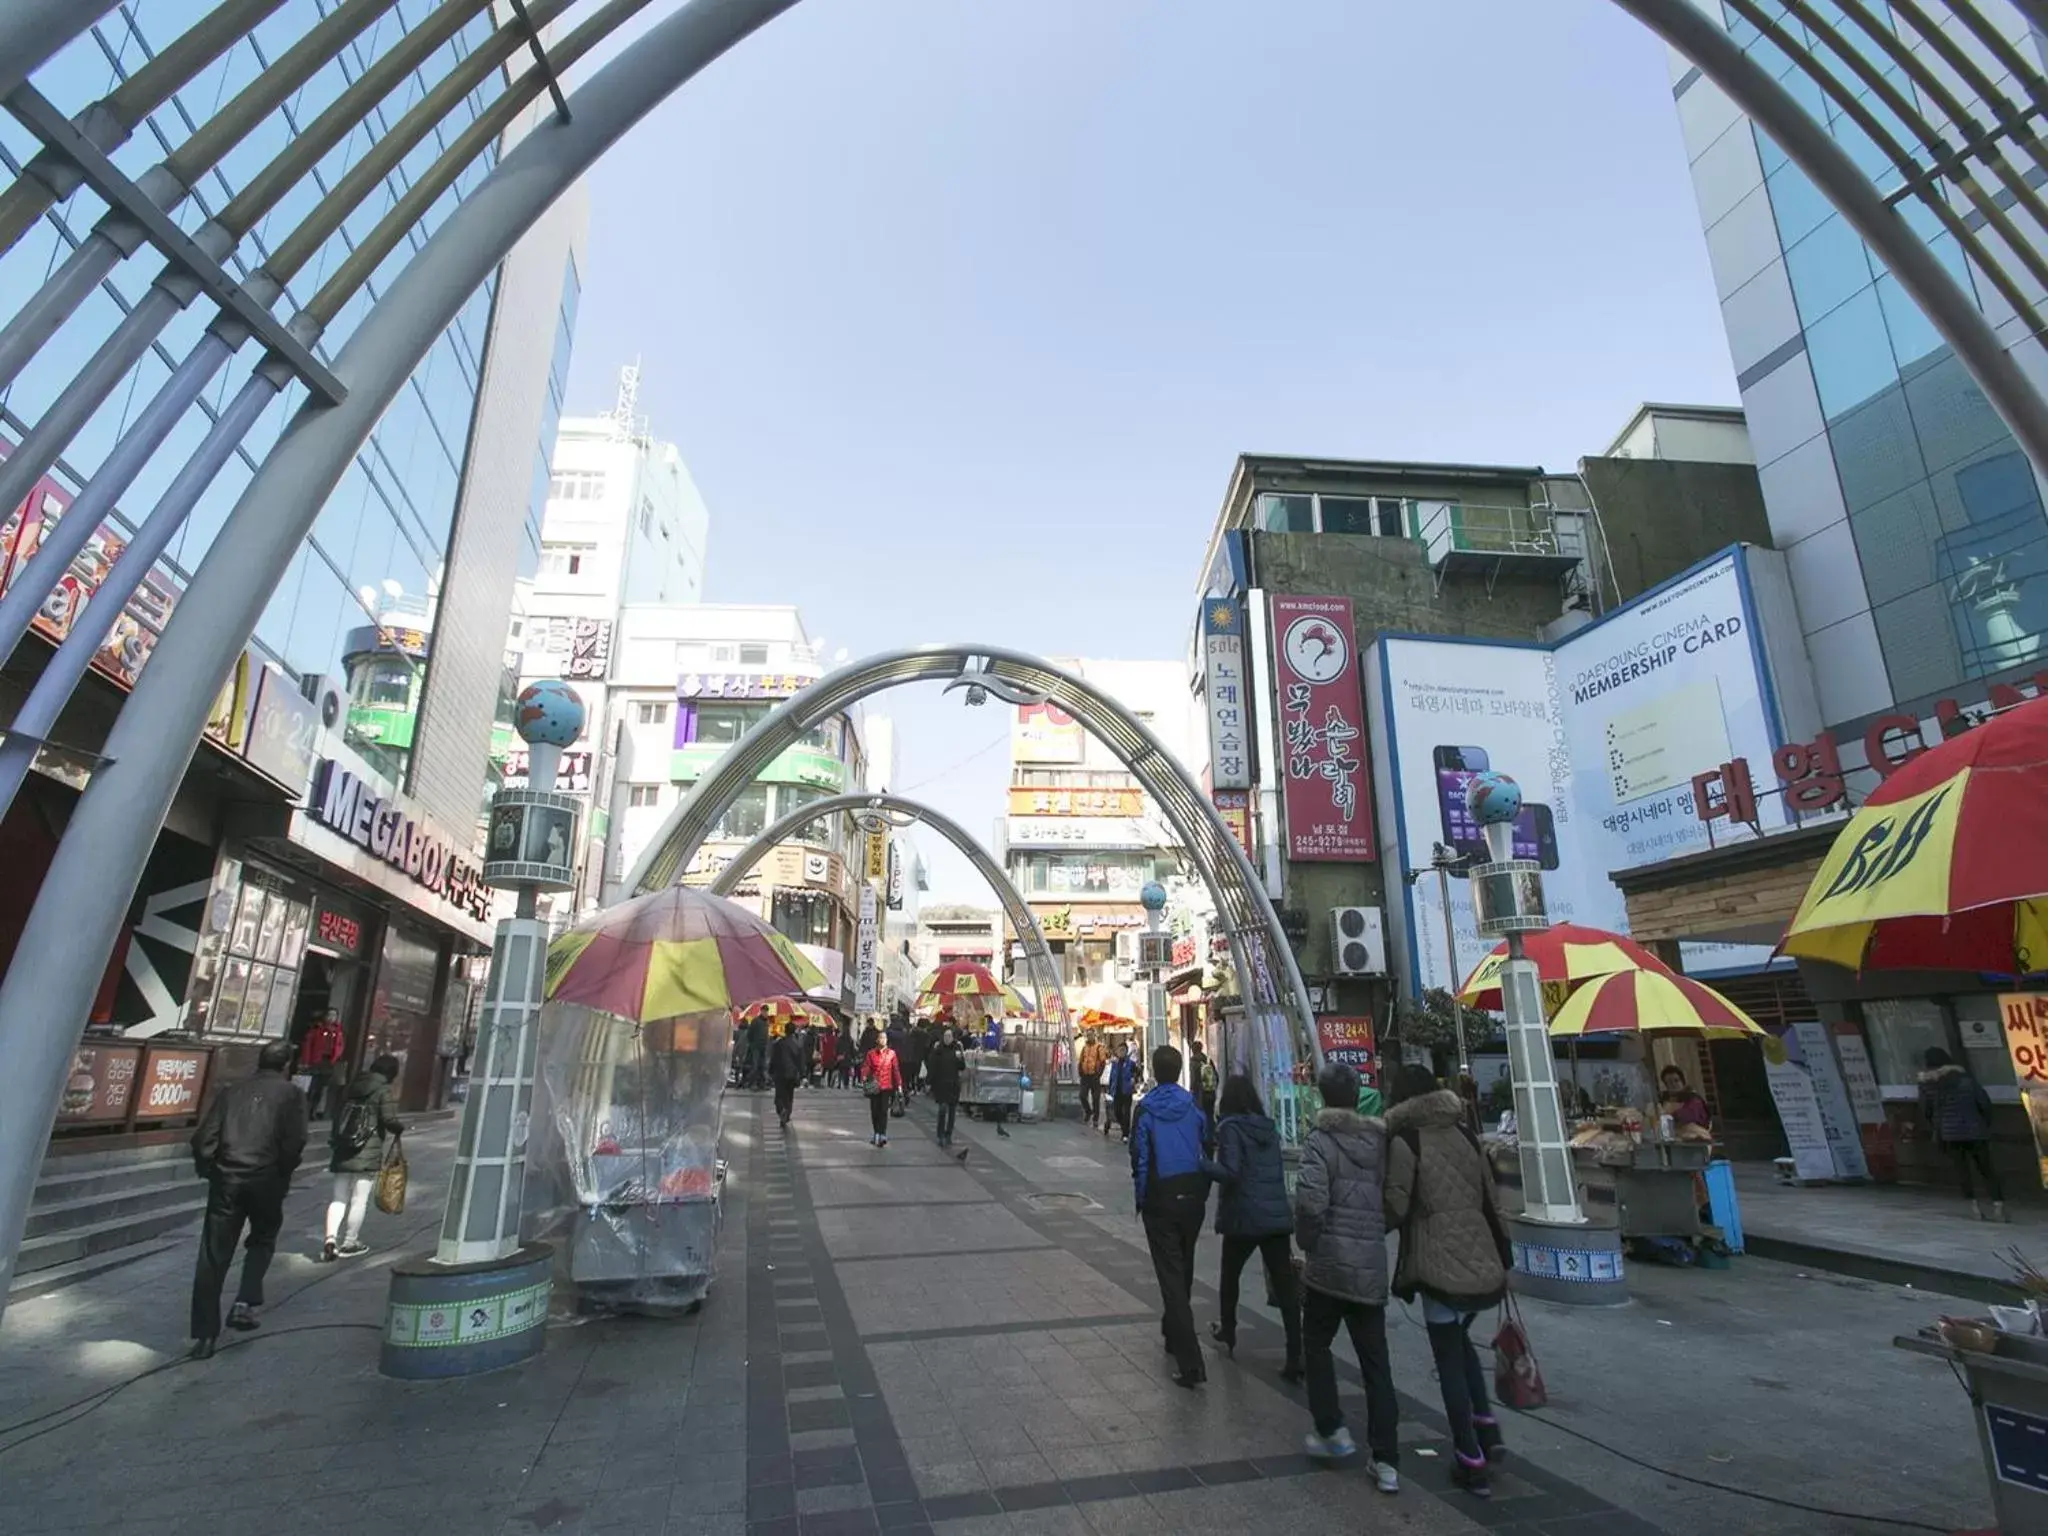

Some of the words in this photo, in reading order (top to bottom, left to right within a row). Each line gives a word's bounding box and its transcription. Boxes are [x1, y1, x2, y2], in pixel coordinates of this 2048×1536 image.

[1574, 645, 1677, 705] MEMBERSHIP
[1683, 616, 1742, 654] CARD
[1577, 641, 1649, 686] DAEYOUNG
[1651, 614, 1711, 650] CINEMA
[1214, 661, 1244, 776] 노래연습장
[1411, 694, 1484, 716] 대영시네마
[317, 759, 453, 902] MEGABOX
[1602, 797, 1673, 834] 대영시네마
[319, 911, 360, 952] 부산극장
[1328, 1050, 1369, 1063] 돼지국밥
